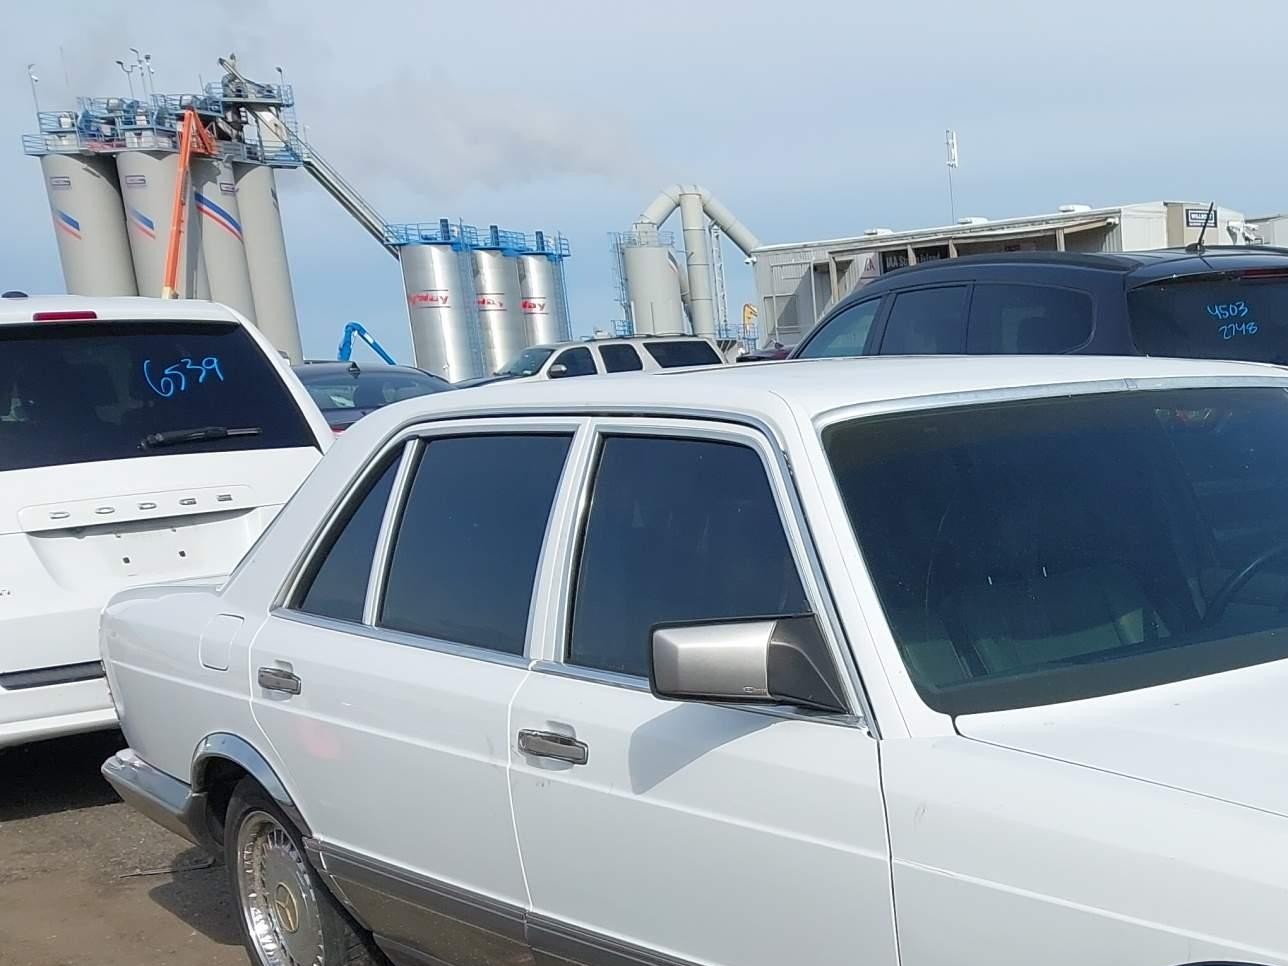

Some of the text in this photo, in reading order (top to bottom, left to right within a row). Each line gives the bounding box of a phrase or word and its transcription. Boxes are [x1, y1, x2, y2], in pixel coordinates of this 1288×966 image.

[1206, 301, 1249, 320] 4503
[1218, 321, 1258, 340] 2748
[143, 357, 224, 397] 6539
[49, 494, 233, 520] DODGE
